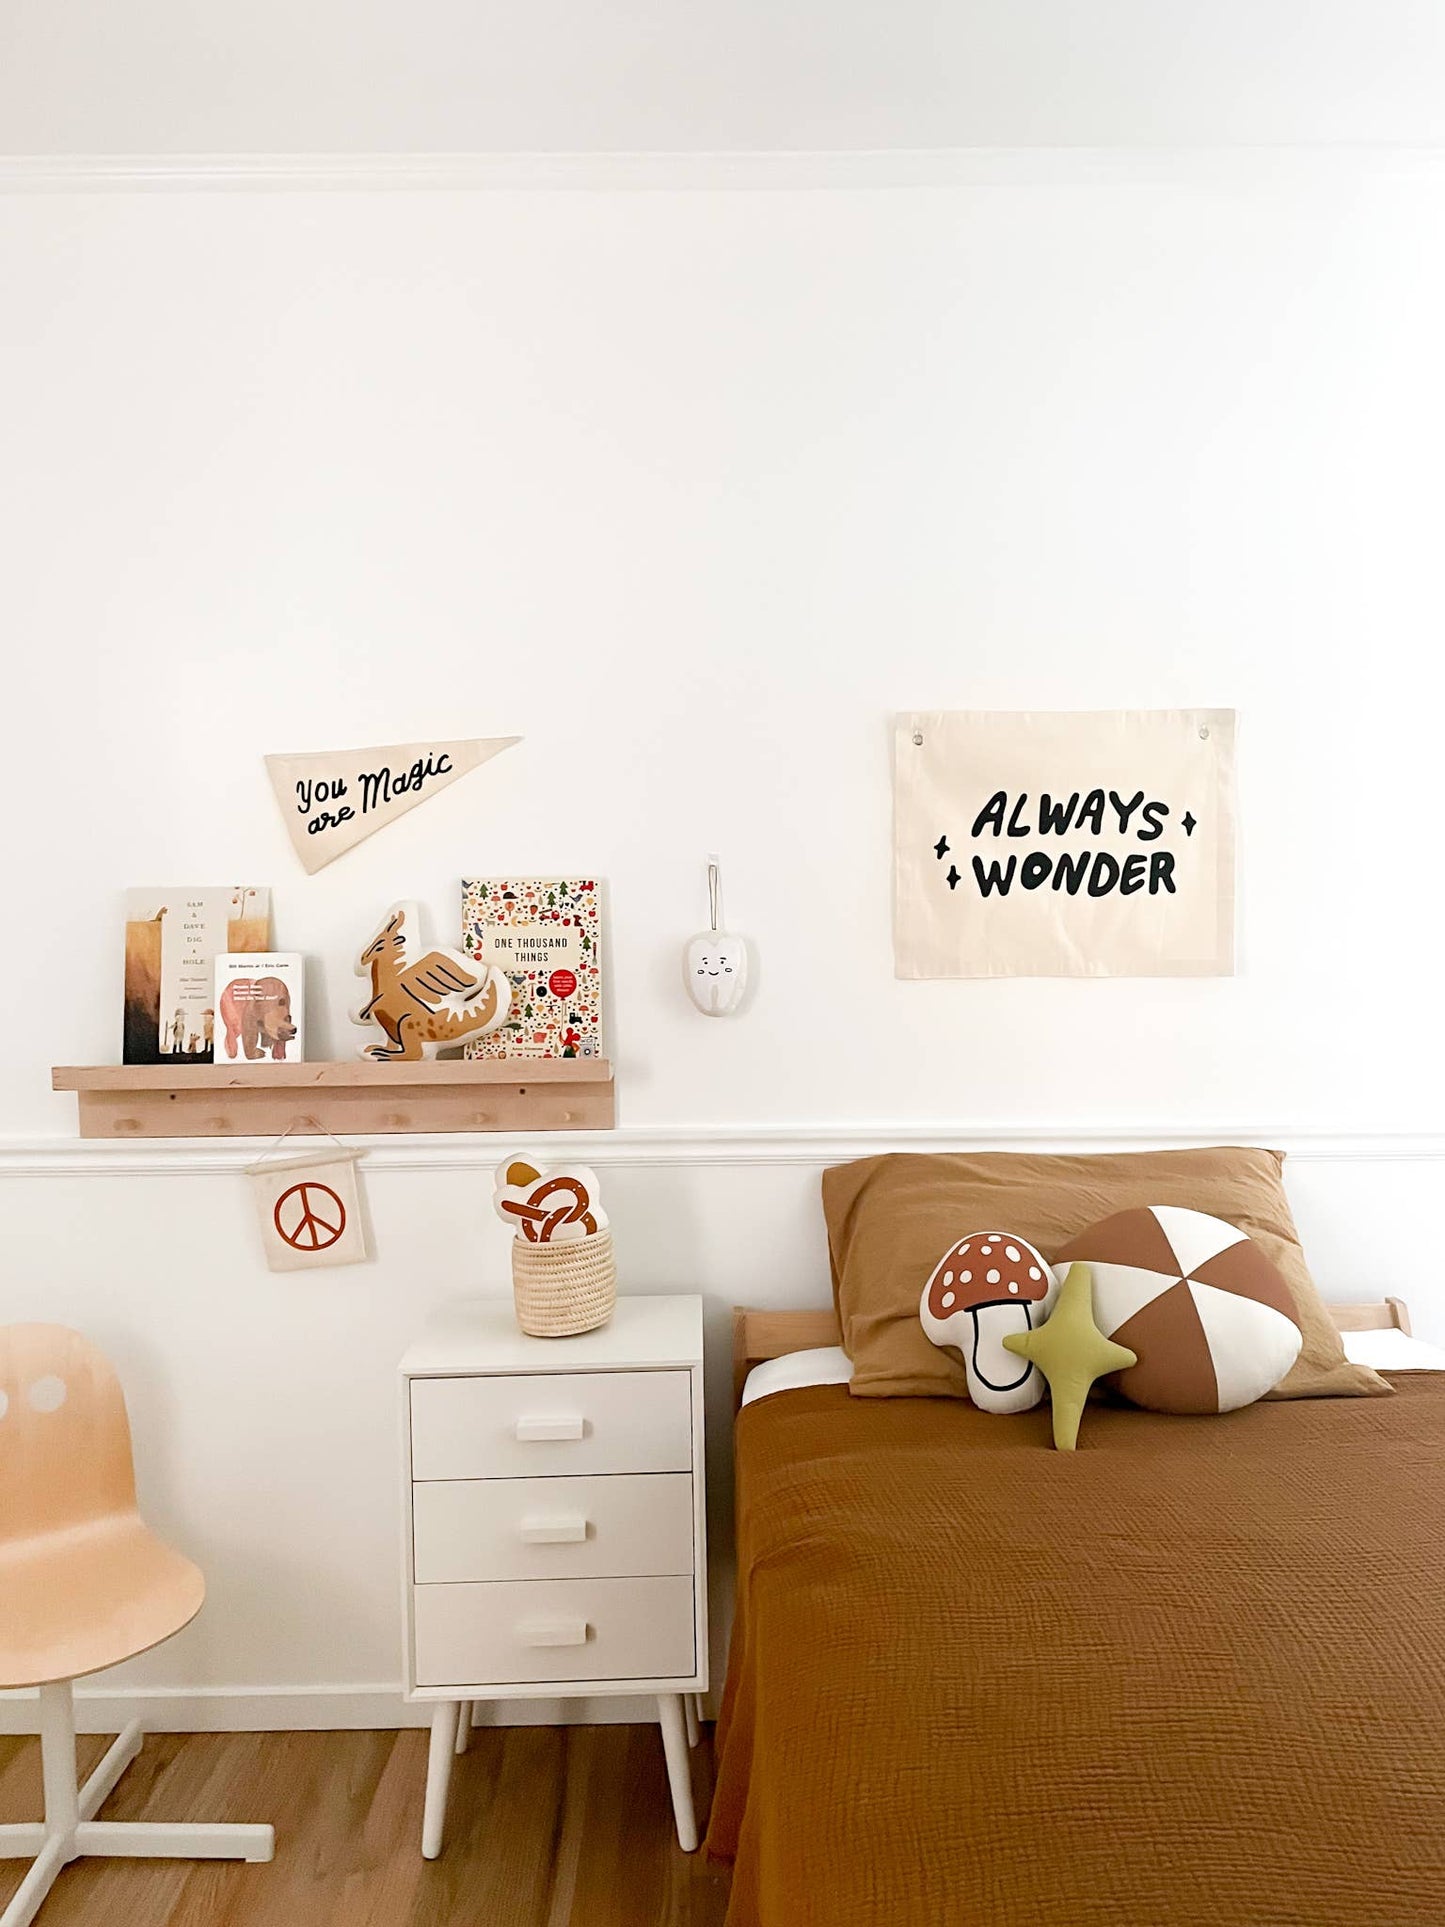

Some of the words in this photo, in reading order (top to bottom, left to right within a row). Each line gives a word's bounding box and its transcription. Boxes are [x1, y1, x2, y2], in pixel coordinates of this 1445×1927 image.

[296, 778, 348, 814] You
[358, 752, 453, 814] Magic
[307, 806, 356, 835] are
[971, 788, 1170, 841] ALWAYS
[971, 850, 1177, 898] WONDER
[494, 938, 513, 949] ONE
[517, 937, 568, 949] THOUSAND
[514, 952, 549, 962] THINGS
[182, 958, 206, 966] HOLE
